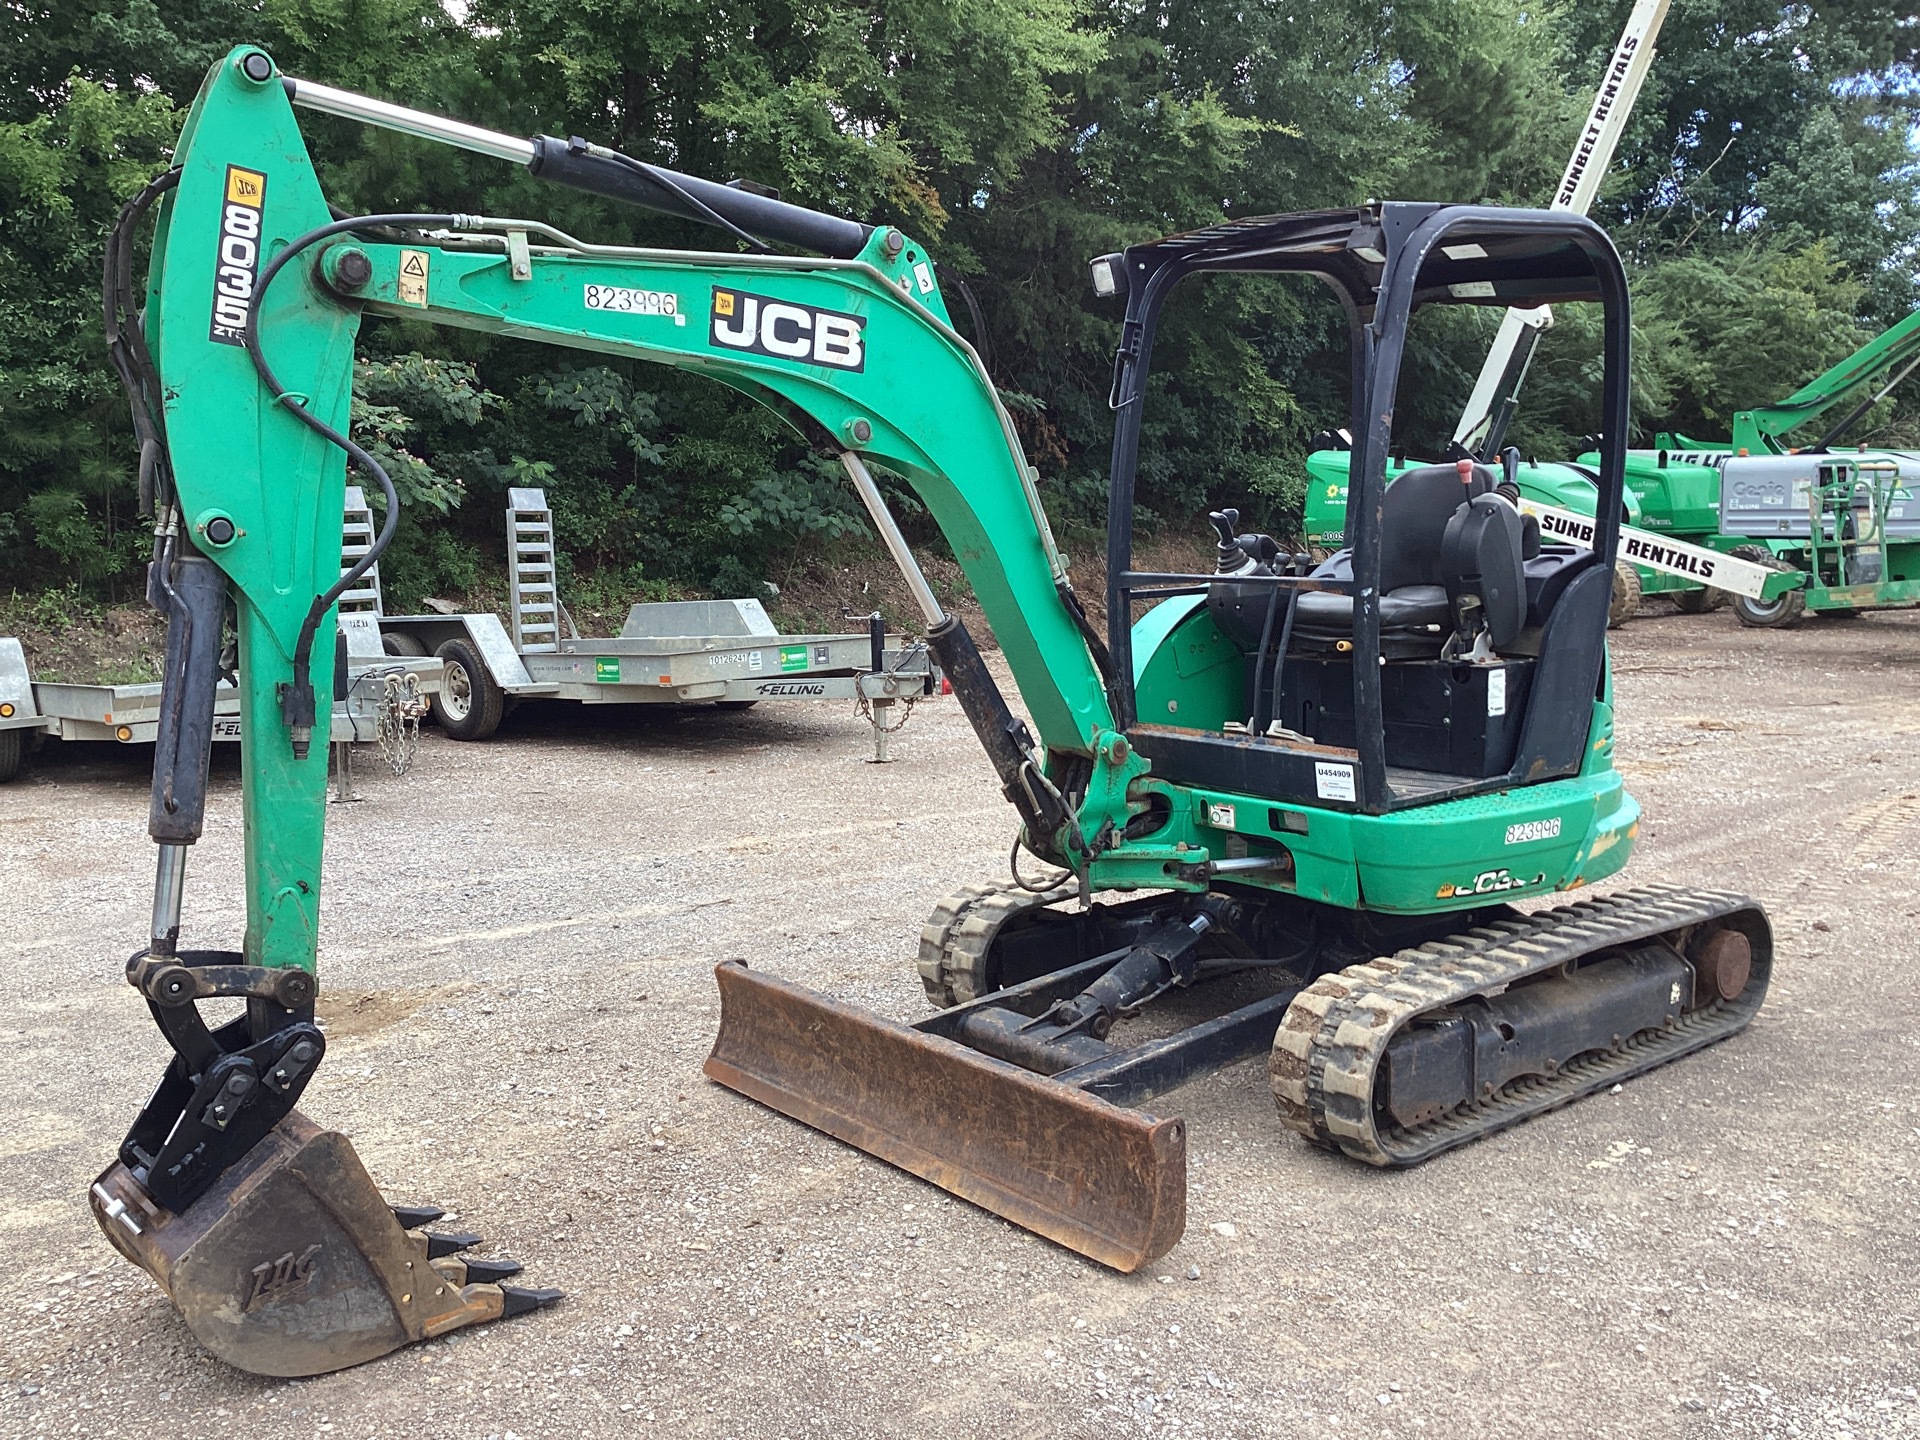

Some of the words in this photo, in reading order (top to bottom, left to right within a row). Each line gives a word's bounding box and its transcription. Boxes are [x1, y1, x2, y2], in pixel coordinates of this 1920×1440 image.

[1559, 124, 1600, 206] SUNBELT
[1595, 36, 1638, 121] RENTALS
[215, 204, 260, 329] 8035
[587, 285, 676, 315] 823996
[714, 297, 862, 367] JCB
[1732, 480, 1786, 498] Genie
[1626, 538, 1715, 578] RENTALS
[756, 682, 825, 696] FELLING
[1318, 768, 1351, 779] U454909
[1506, 818, 1560, 843] 823996
